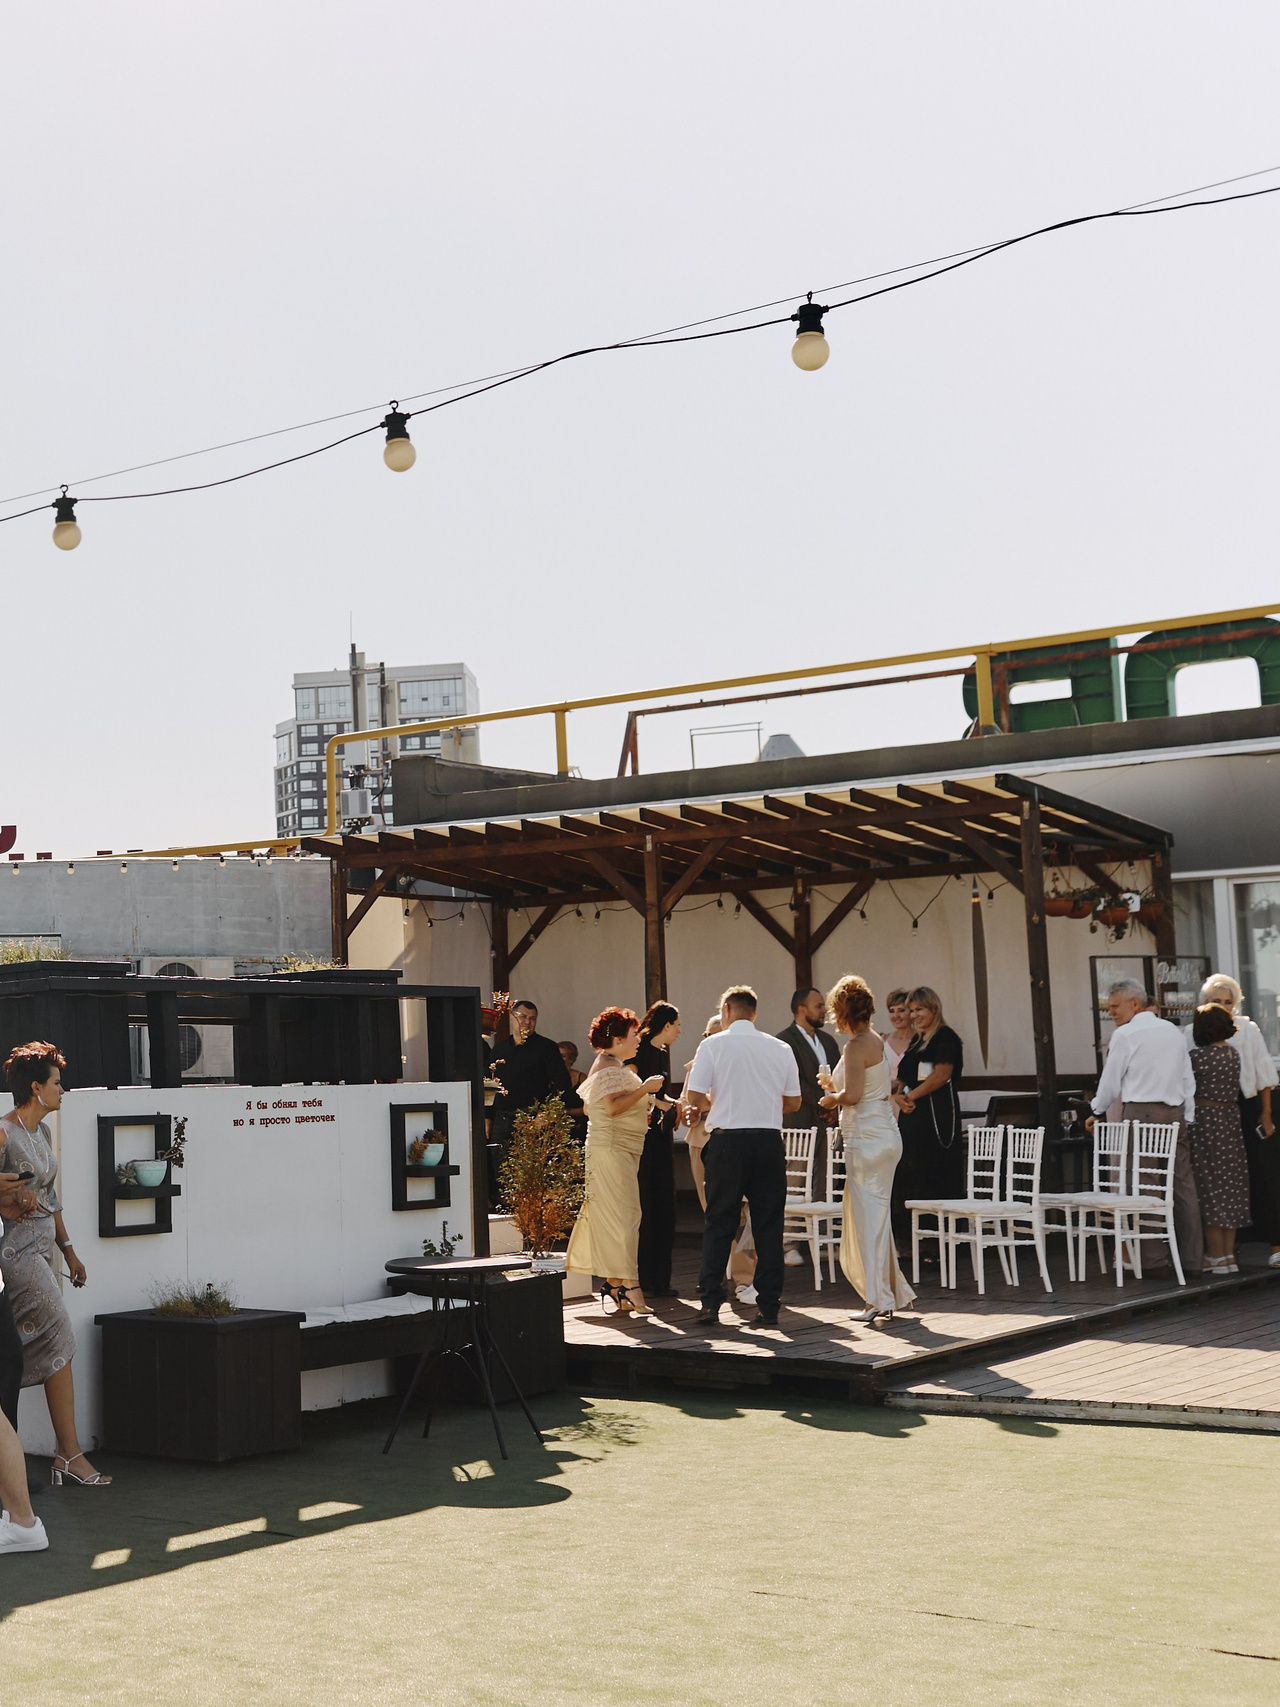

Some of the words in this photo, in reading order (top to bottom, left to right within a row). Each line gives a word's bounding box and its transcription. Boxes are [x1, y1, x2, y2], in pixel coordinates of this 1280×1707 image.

[245, 1101, 252, 1110] Я
[256, 1100, 268, 1110] бы
[272, 1099, 298, 1109] обнял
[302, 1098, 323, 1108] тебя
[232, 1118, 245, 1127] но
[248, 1118, 255, 1126] я
[260, 1117, 291, 1127] просто
[294, 1114, 336, 1125] цветочек
